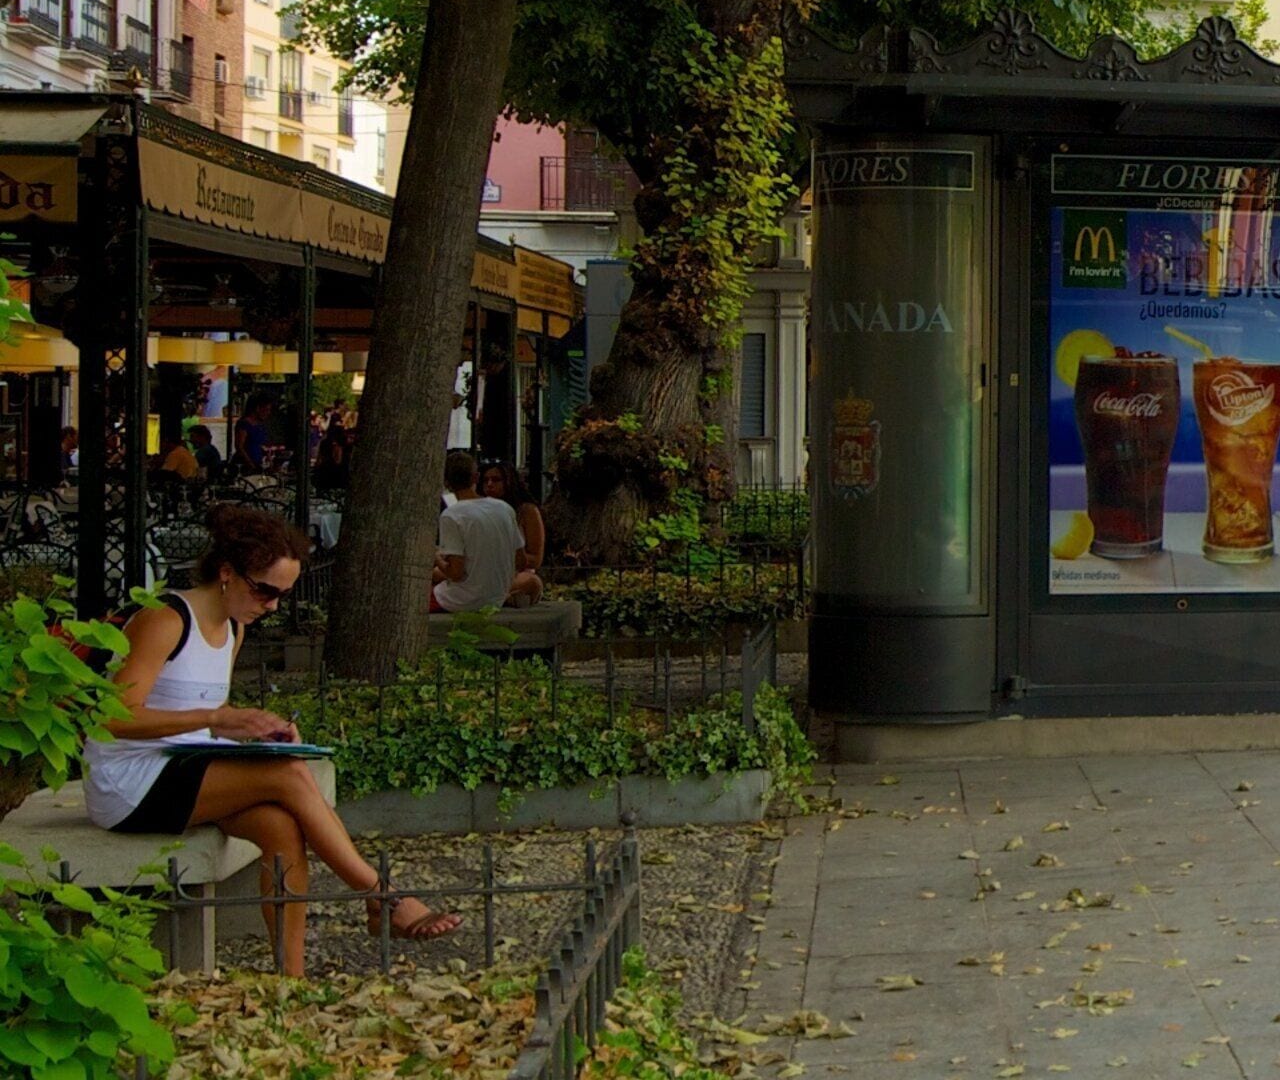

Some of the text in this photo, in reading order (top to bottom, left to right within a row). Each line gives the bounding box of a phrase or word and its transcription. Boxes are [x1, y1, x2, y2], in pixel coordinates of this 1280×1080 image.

[1116, 163, 1251, 191] FLORES
[195, 163, 255, 221] Restaurante
[1157, 197, 1215, 209] JCDecaux
[1139, 300, 1227, 321] ¿Quedamos?
[1222, 390, 1263, 408] Lipton
